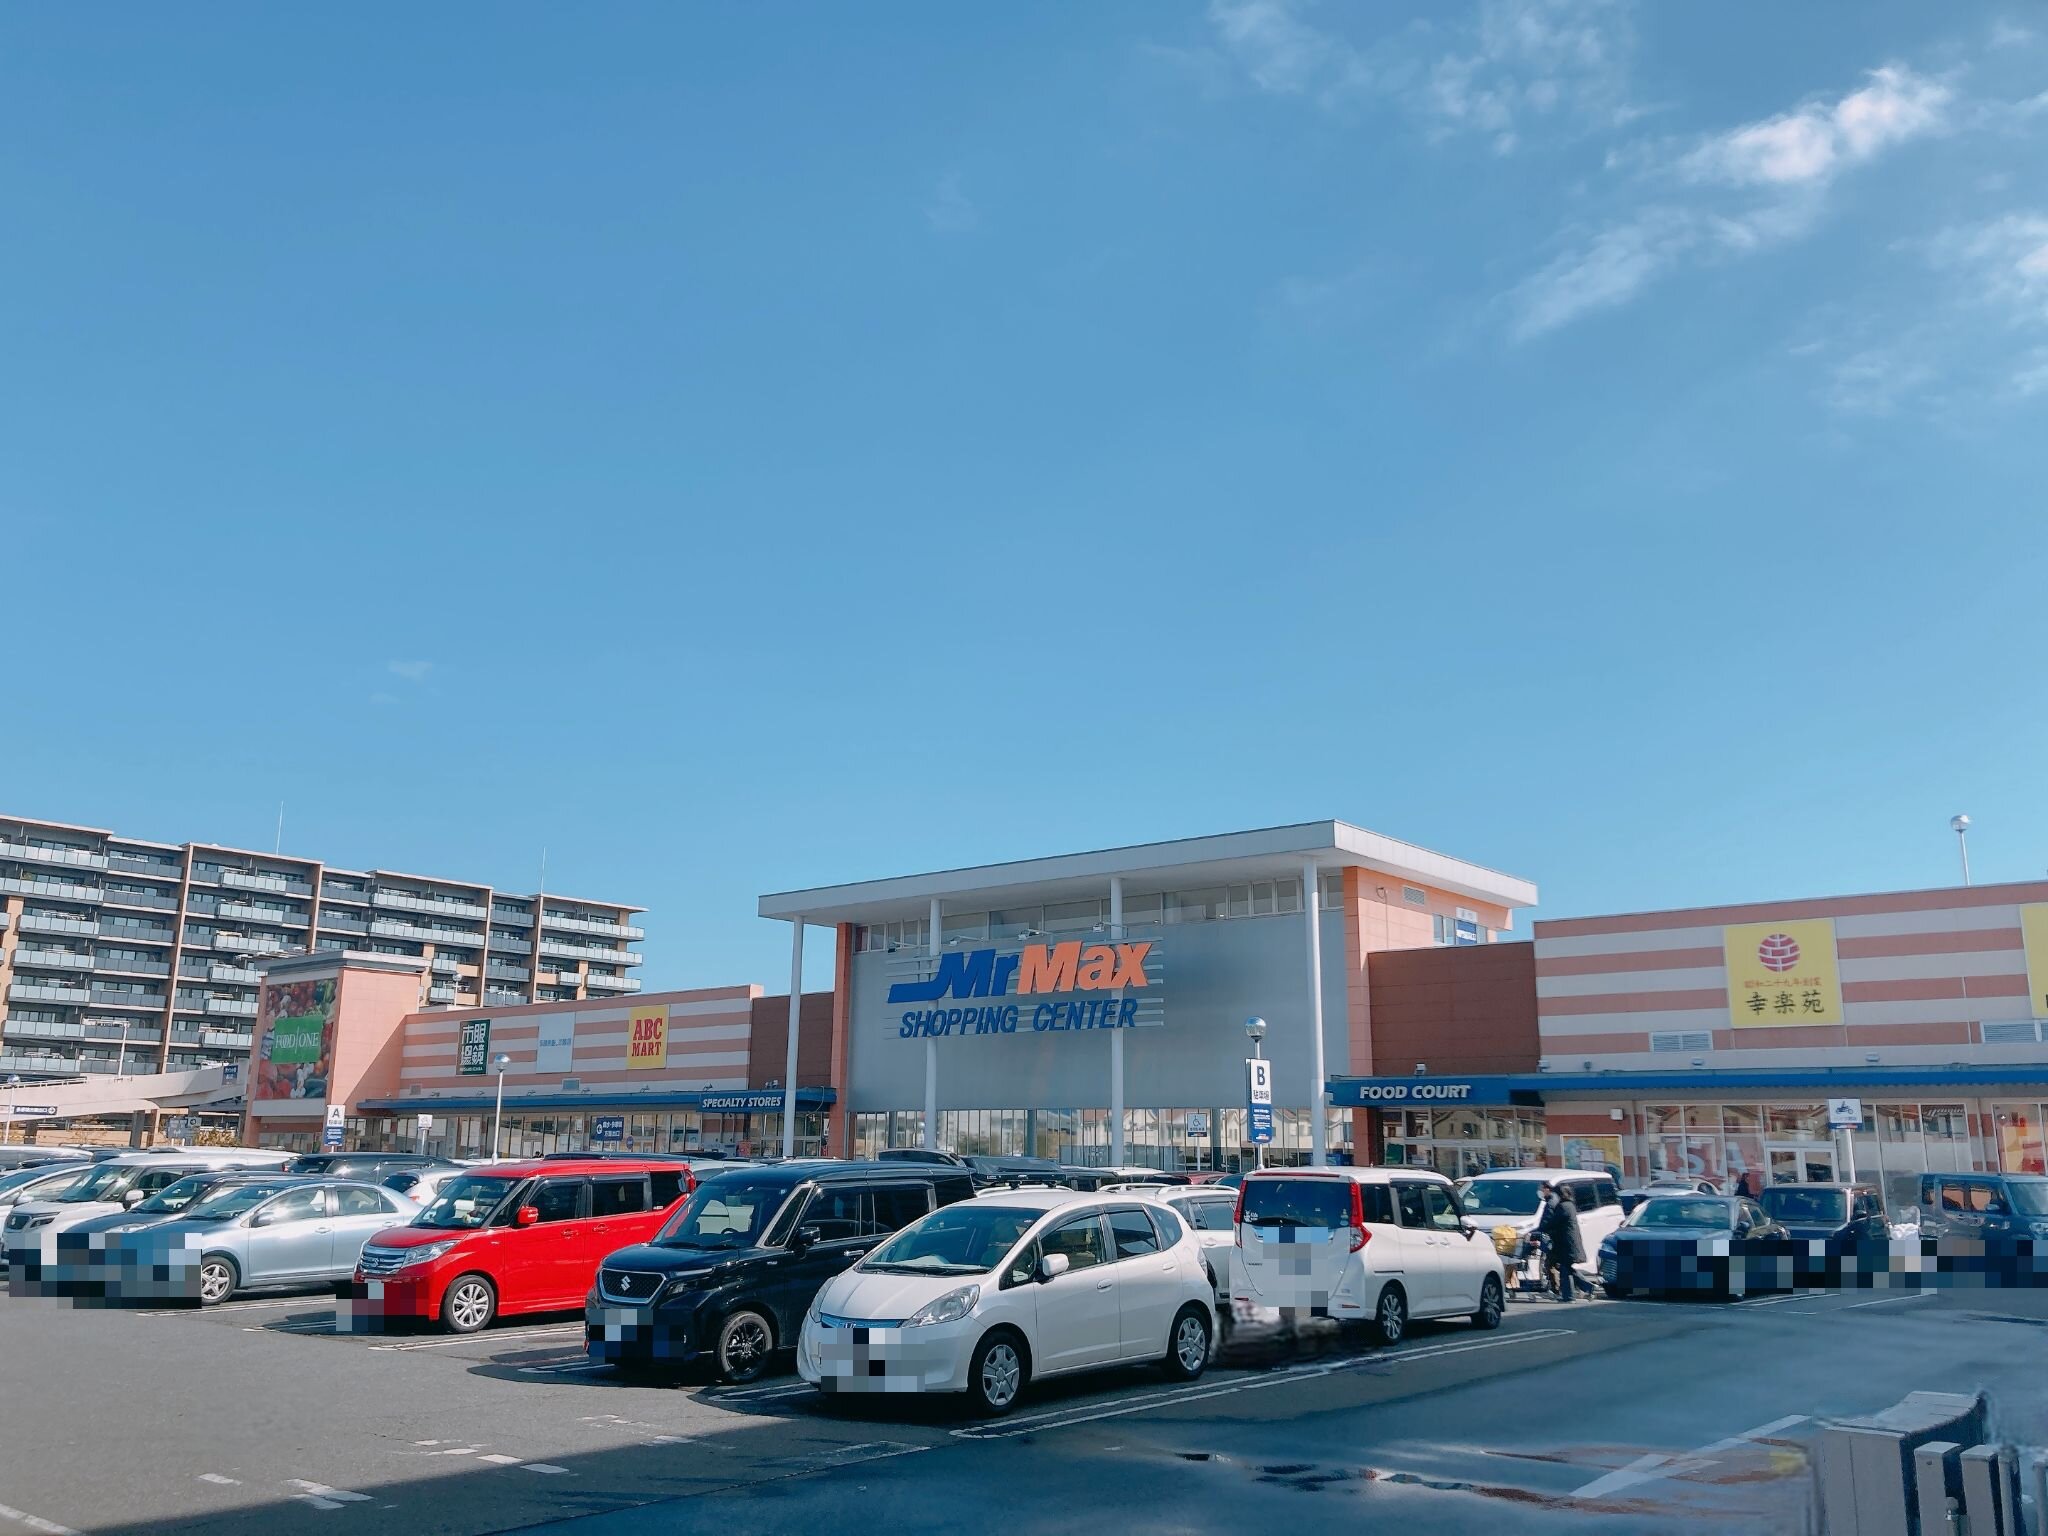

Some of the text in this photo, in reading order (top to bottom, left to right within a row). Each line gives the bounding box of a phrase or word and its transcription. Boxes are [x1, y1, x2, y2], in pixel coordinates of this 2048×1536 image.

[1745, 989, 1824, 1016] 幸楽苑
[900, 999, 1138, 1038] SHOPPING CENTER
[633, 1018, 663, 1040] ABC
[299, 1032, 320, 1047] ONE
[632, 1042, 661, 1057] MART
[1257, 1066, 1265, 1085] B
[1360, 1085, 1471, 1099] FOOD COURT
[702, 1096, 781, 1108] SPECIALTY STORES
[332, 1108, 340, 1118] A
